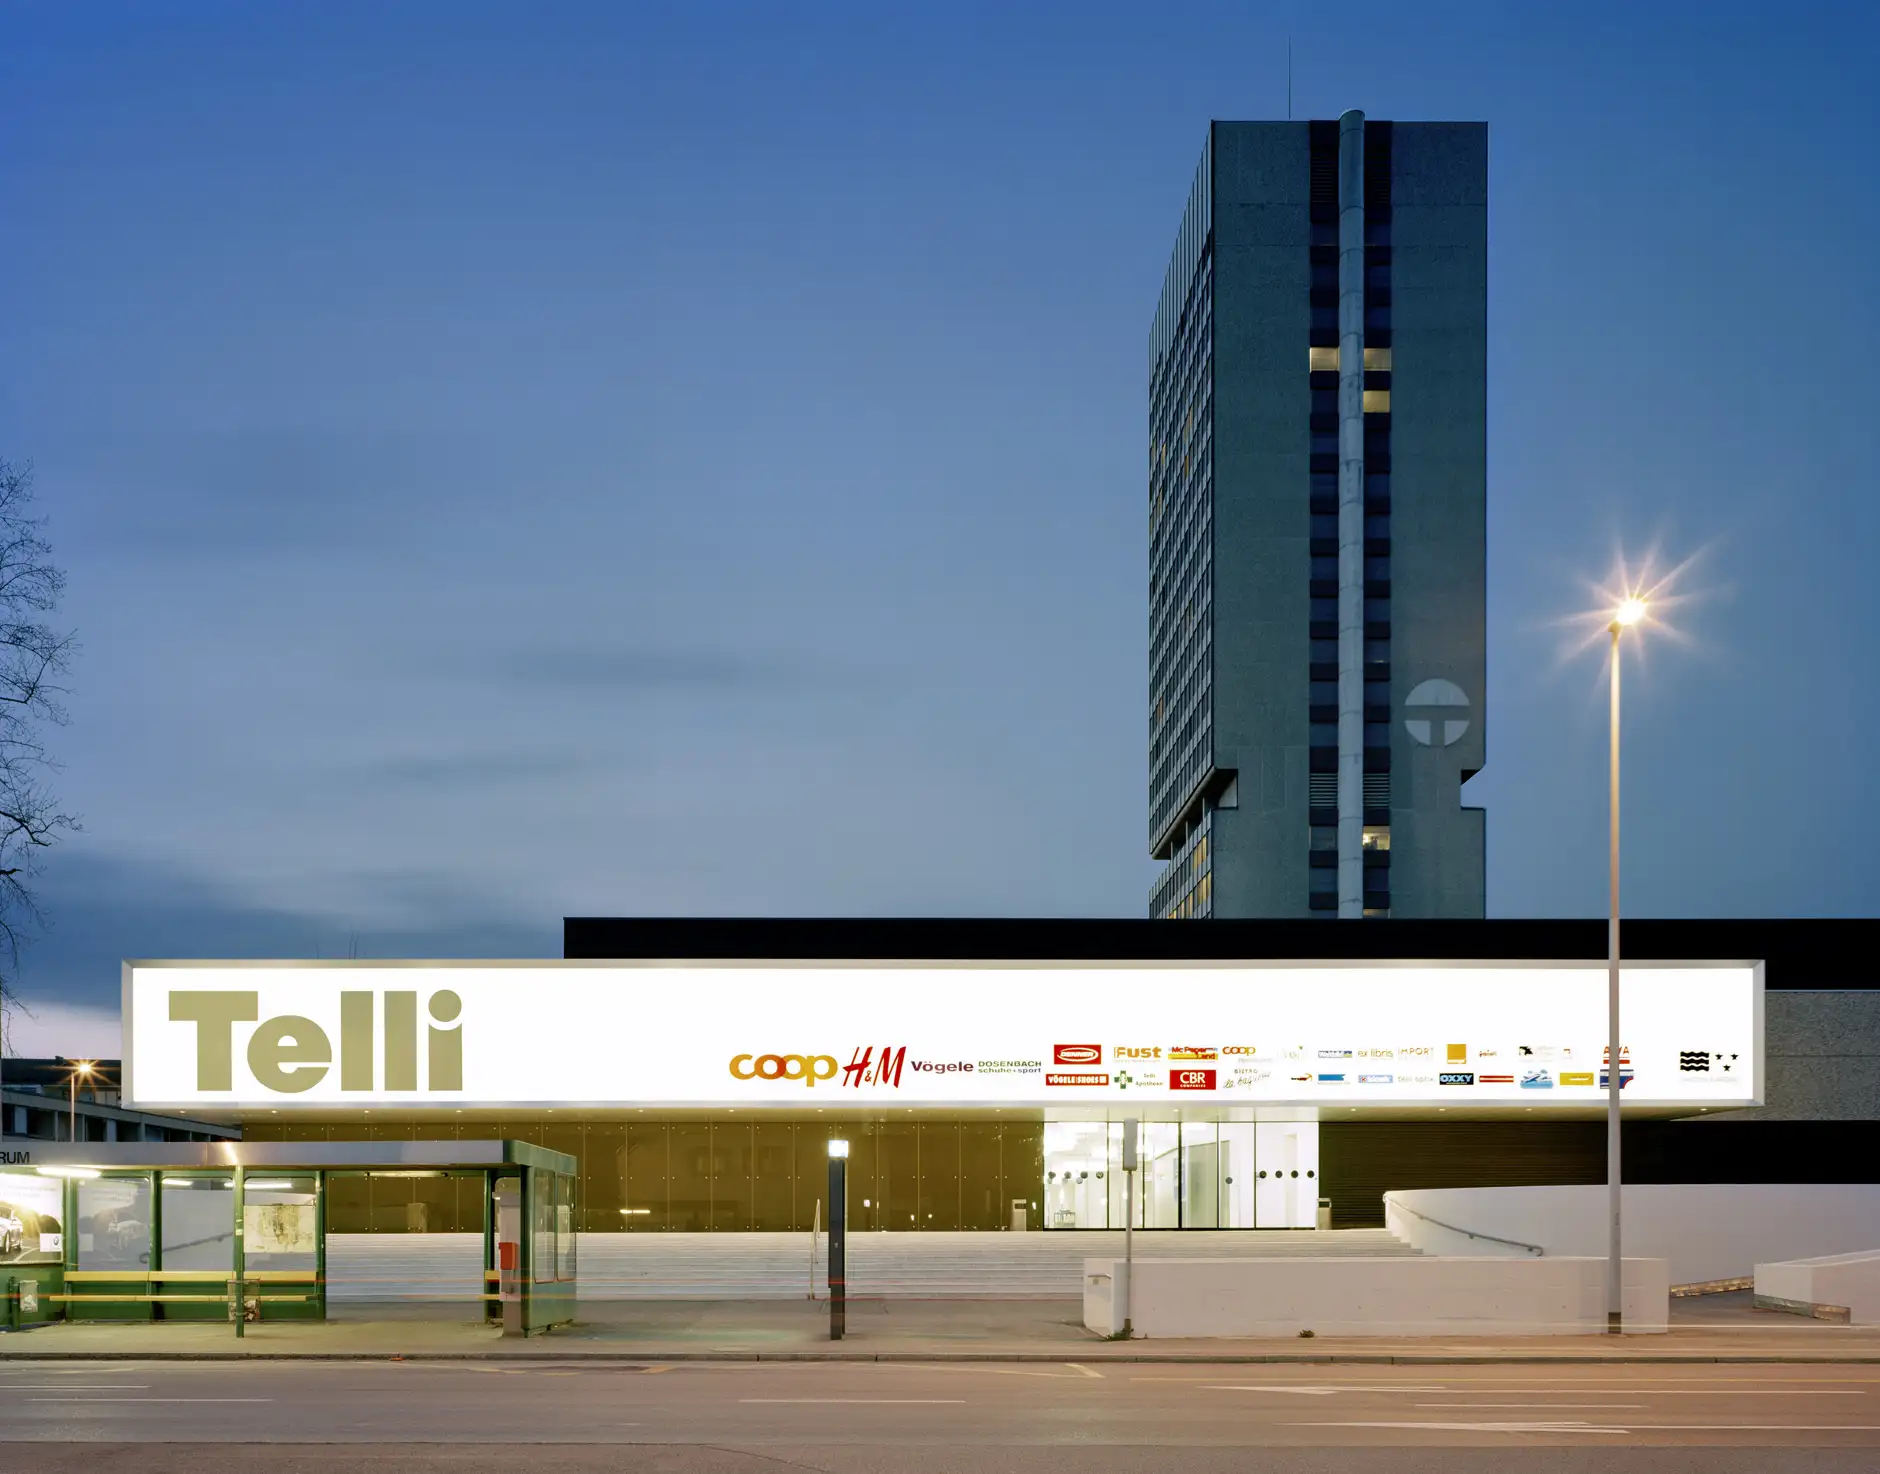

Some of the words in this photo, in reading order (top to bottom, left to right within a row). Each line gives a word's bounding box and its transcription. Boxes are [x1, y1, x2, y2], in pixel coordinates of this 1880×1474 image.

[169, 989, 463, 1094] Telli
[1222, 1046, 1257, 1056] coop
[729, 1053, 838, 1087] coop
[843, 1046, 907, 1089] H&M
[911, 1059, 974, 1075] Vögele
[978, 1060, 1042, 1068] DOSENBACH
[1180, 1071, 1206, 1084] CBR
[1440, 1074, 1472, 1083] OXXY
